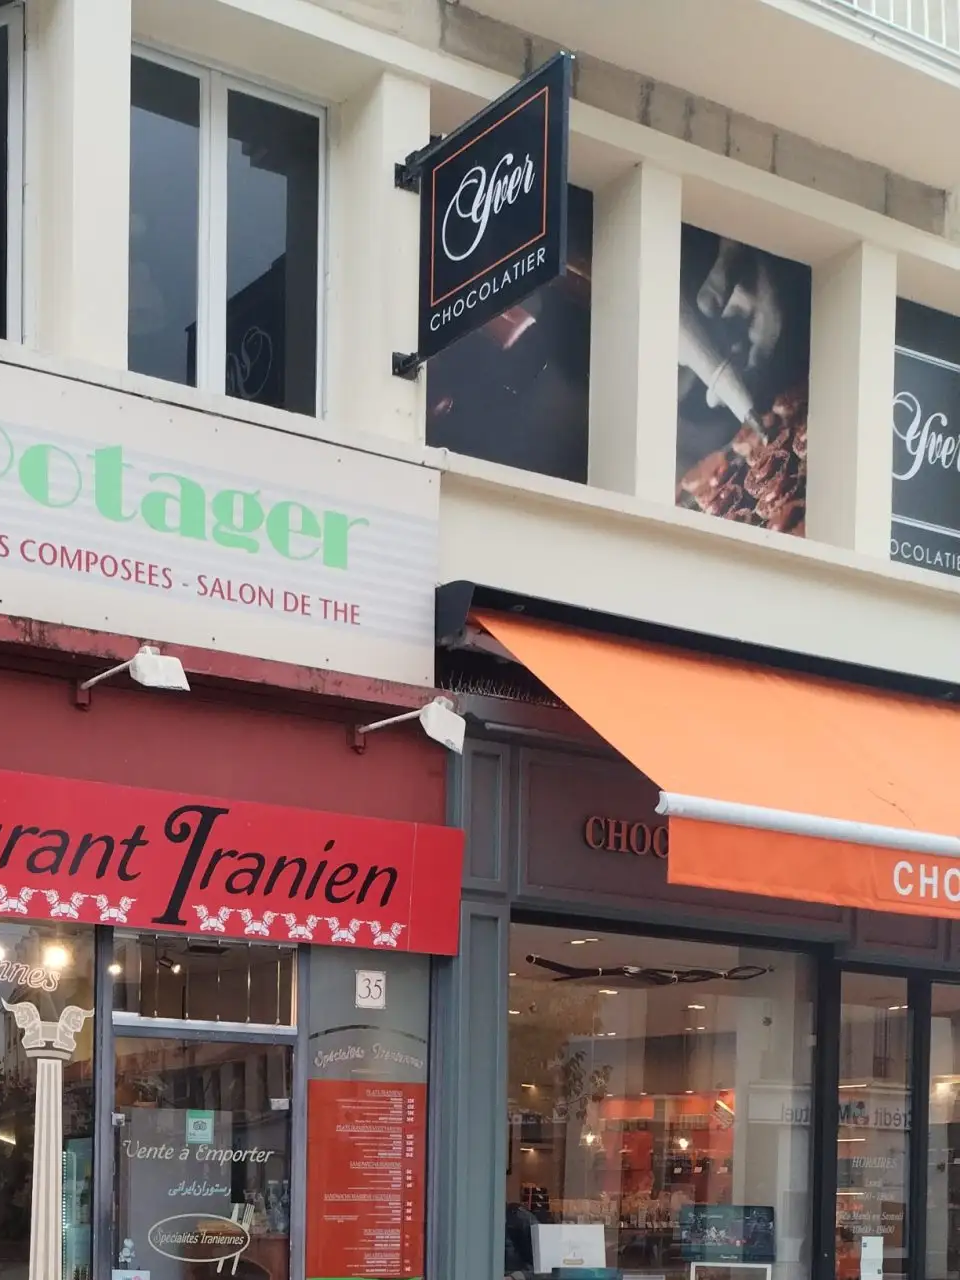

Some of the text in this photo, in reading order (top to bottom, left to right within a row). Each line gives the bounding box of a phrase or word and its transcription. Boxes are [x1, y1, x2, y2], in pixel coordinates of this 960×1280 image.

[442, 152, 535, 261] Yver
[429, 246, 547, 332] CHOCOLATIER
[19, 538, 173, 591] COMPOSEES
[196, 573, 274, 611] SALON
[282, 591, 312, 617] DE
[319, 598, 361, 627] THE
[890, 538, 960, 571] OCOLATIE
[151, 804, 400, 927] Iranien
[358, 977, 384, 1001] 35
[123, 1140, 174, 1161] Vente
[195, 1144, 275, 1166] Emporter
